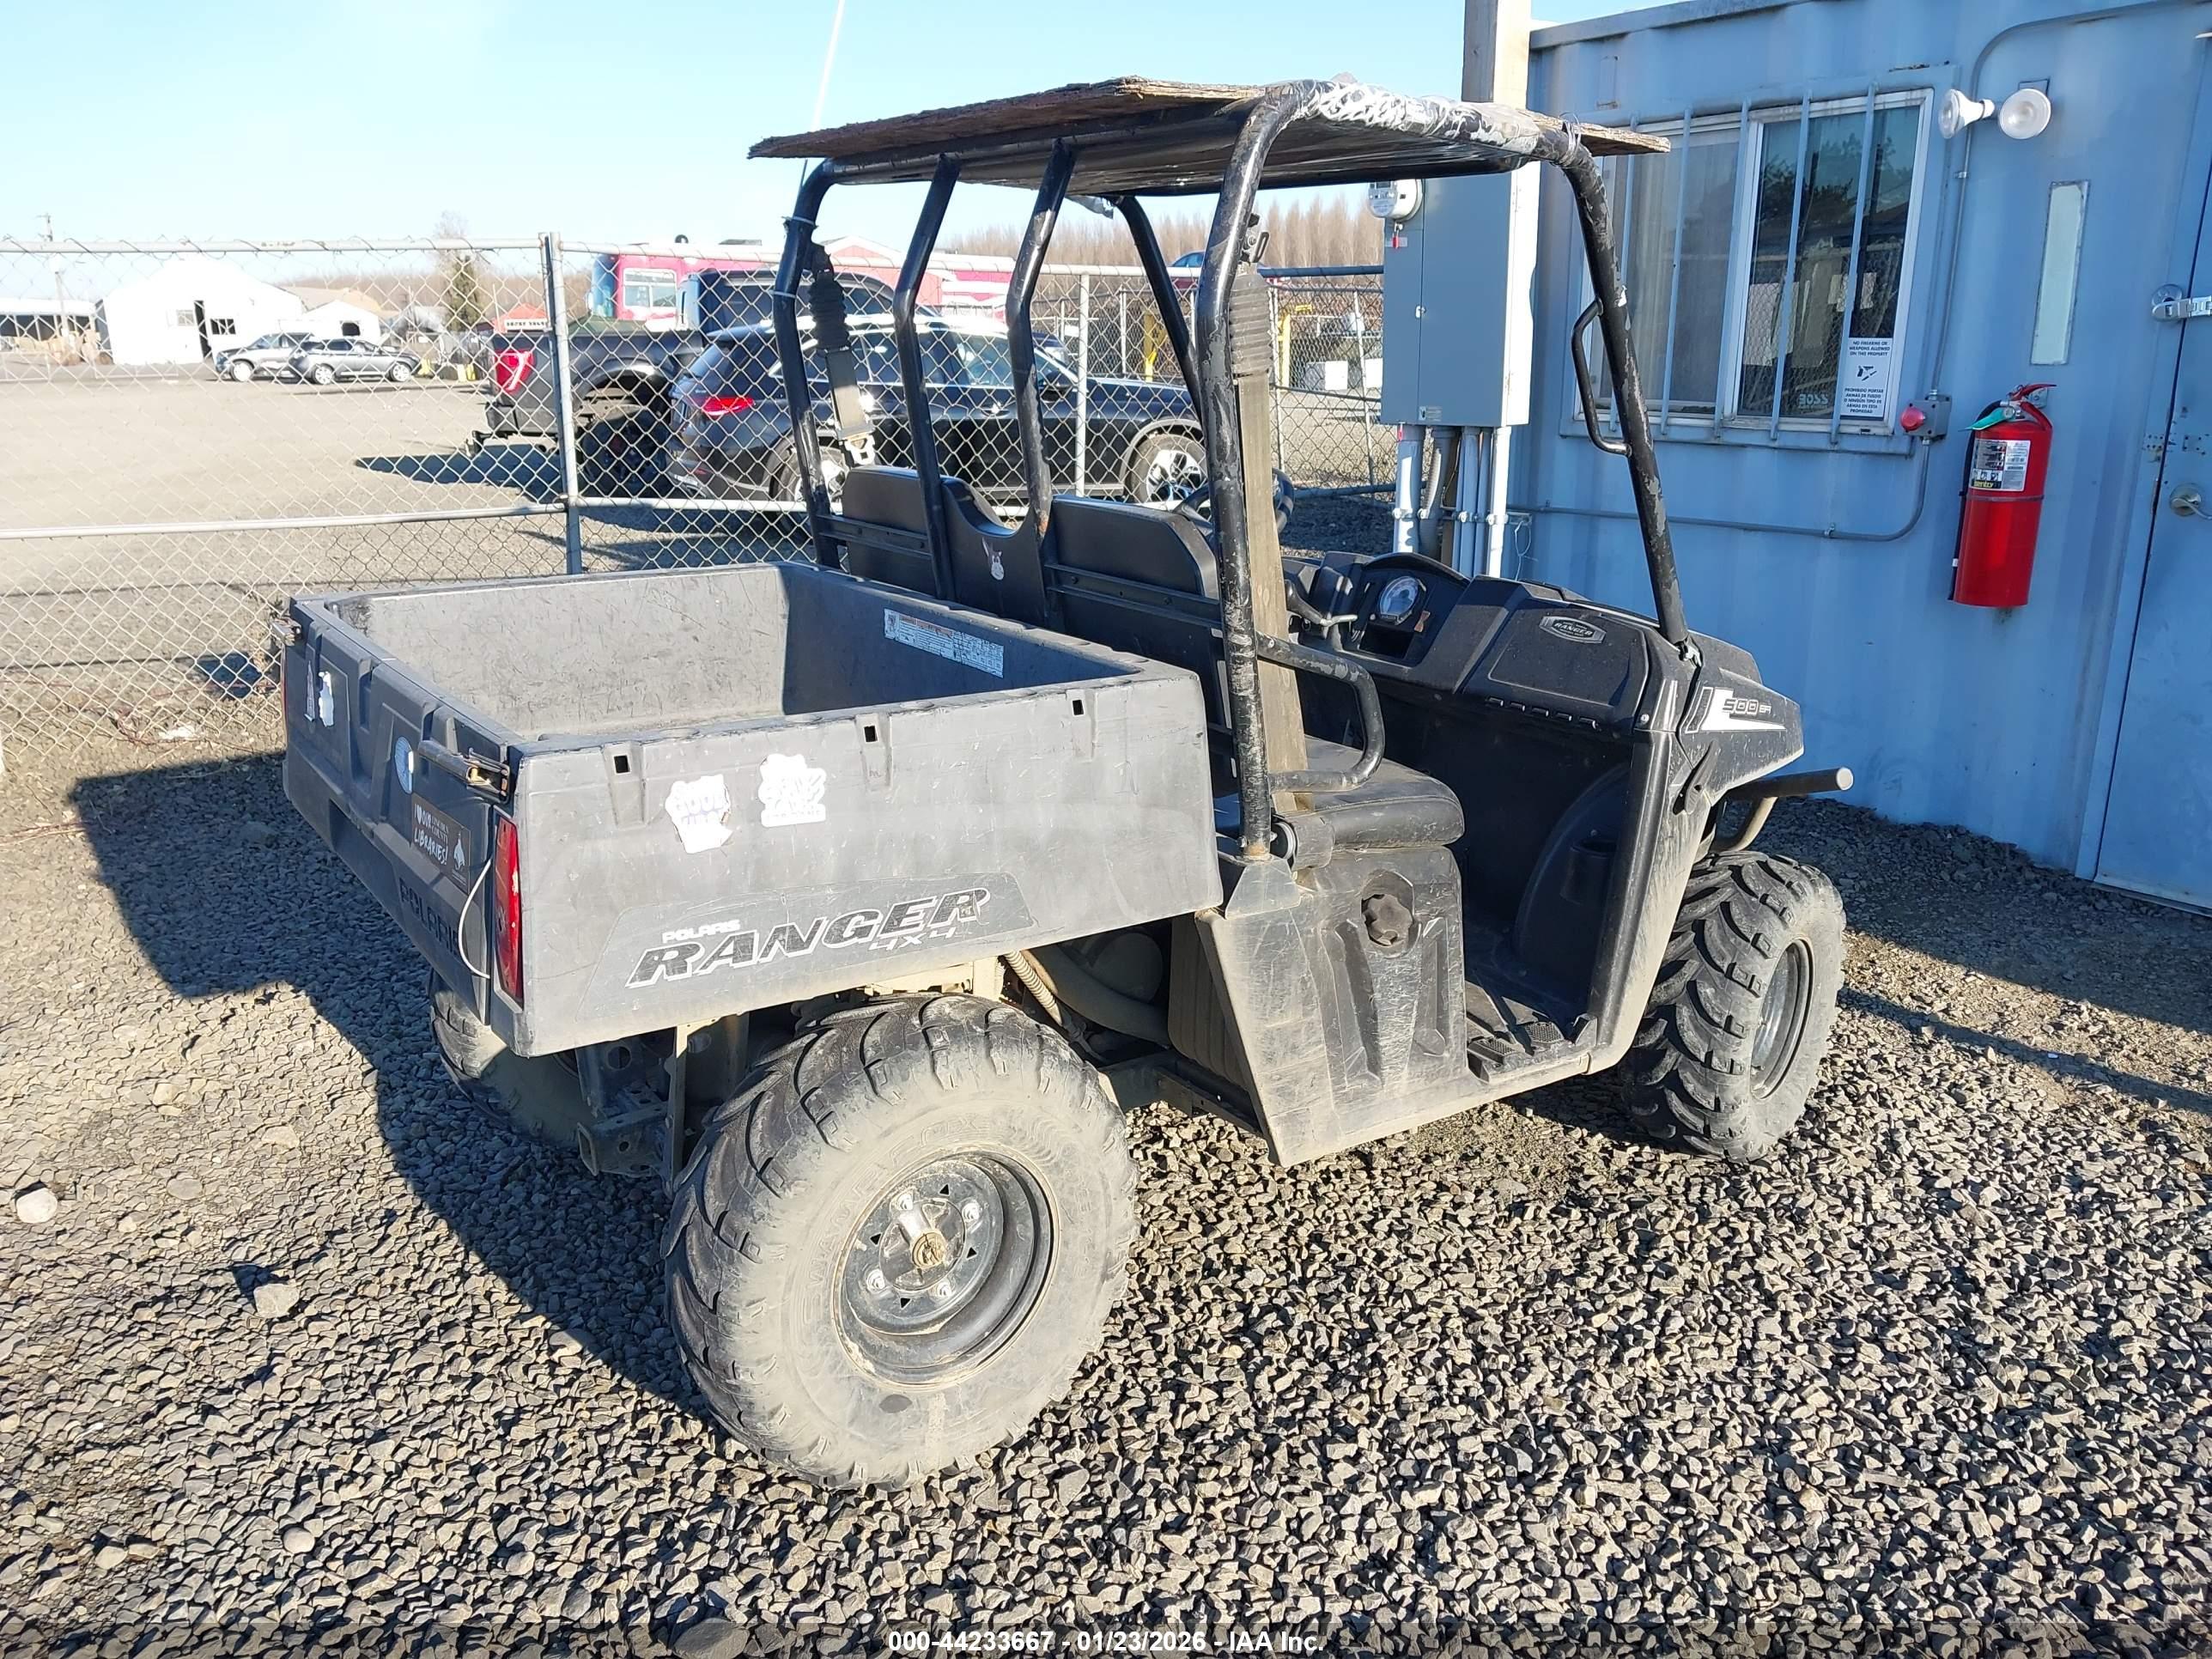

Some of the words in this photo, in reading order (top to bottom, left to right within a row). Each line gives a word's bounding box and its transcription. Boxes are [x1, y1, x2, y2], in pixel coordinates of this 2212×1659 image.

[1554, 623, 1594, 635] RANGER
[1723, 698, 1759, 714] 500
[414, 827, 448, 866] LIBRARIES!
[624, 887, 991, 988] RANGER
[662, 919, 741, 944] POLARIS
